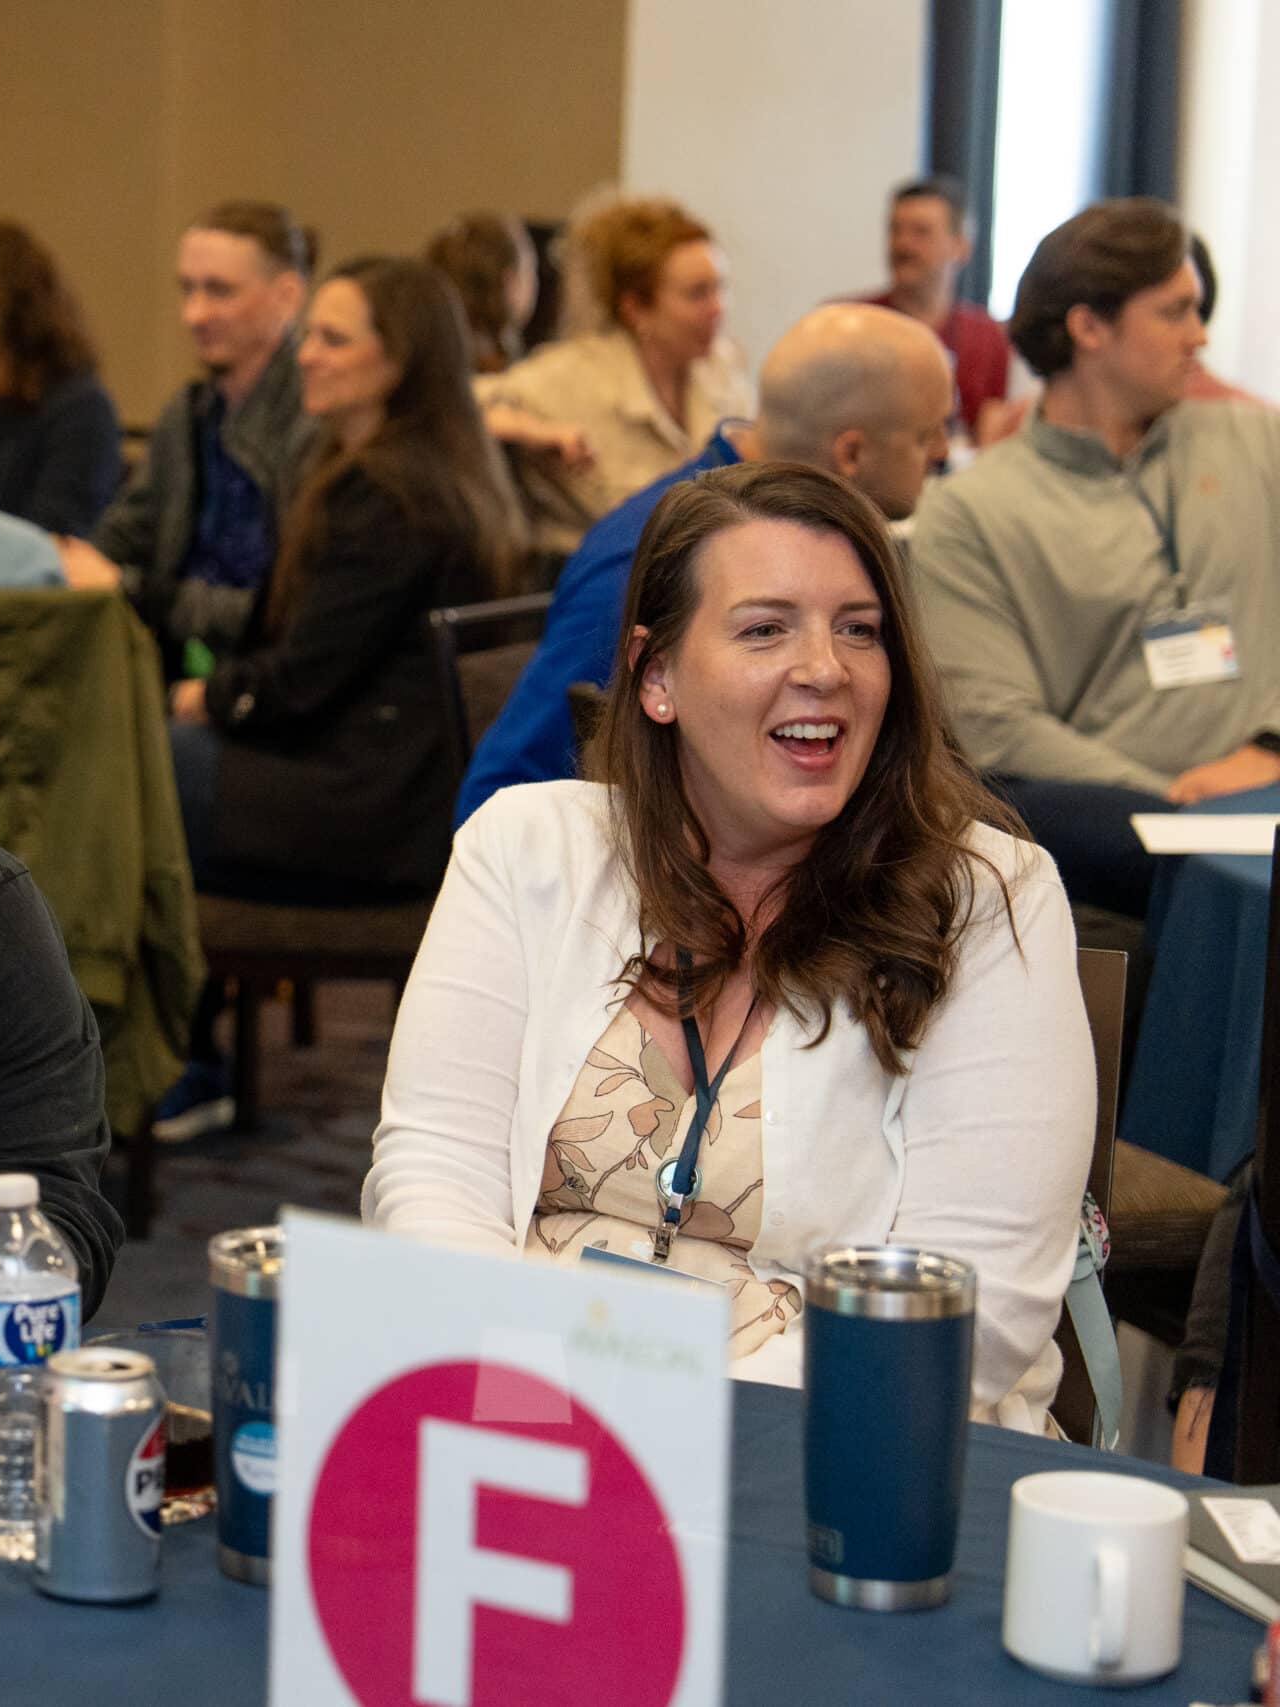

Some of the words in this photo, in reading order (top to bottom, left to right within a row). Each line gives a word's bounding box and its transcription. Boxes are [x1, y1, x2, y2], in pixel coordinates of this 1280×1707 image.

[13, 1303, 59, 1323] Pure
[19, 1321, 56, 1344] Life
[412, 1416, 589, 1707] F
